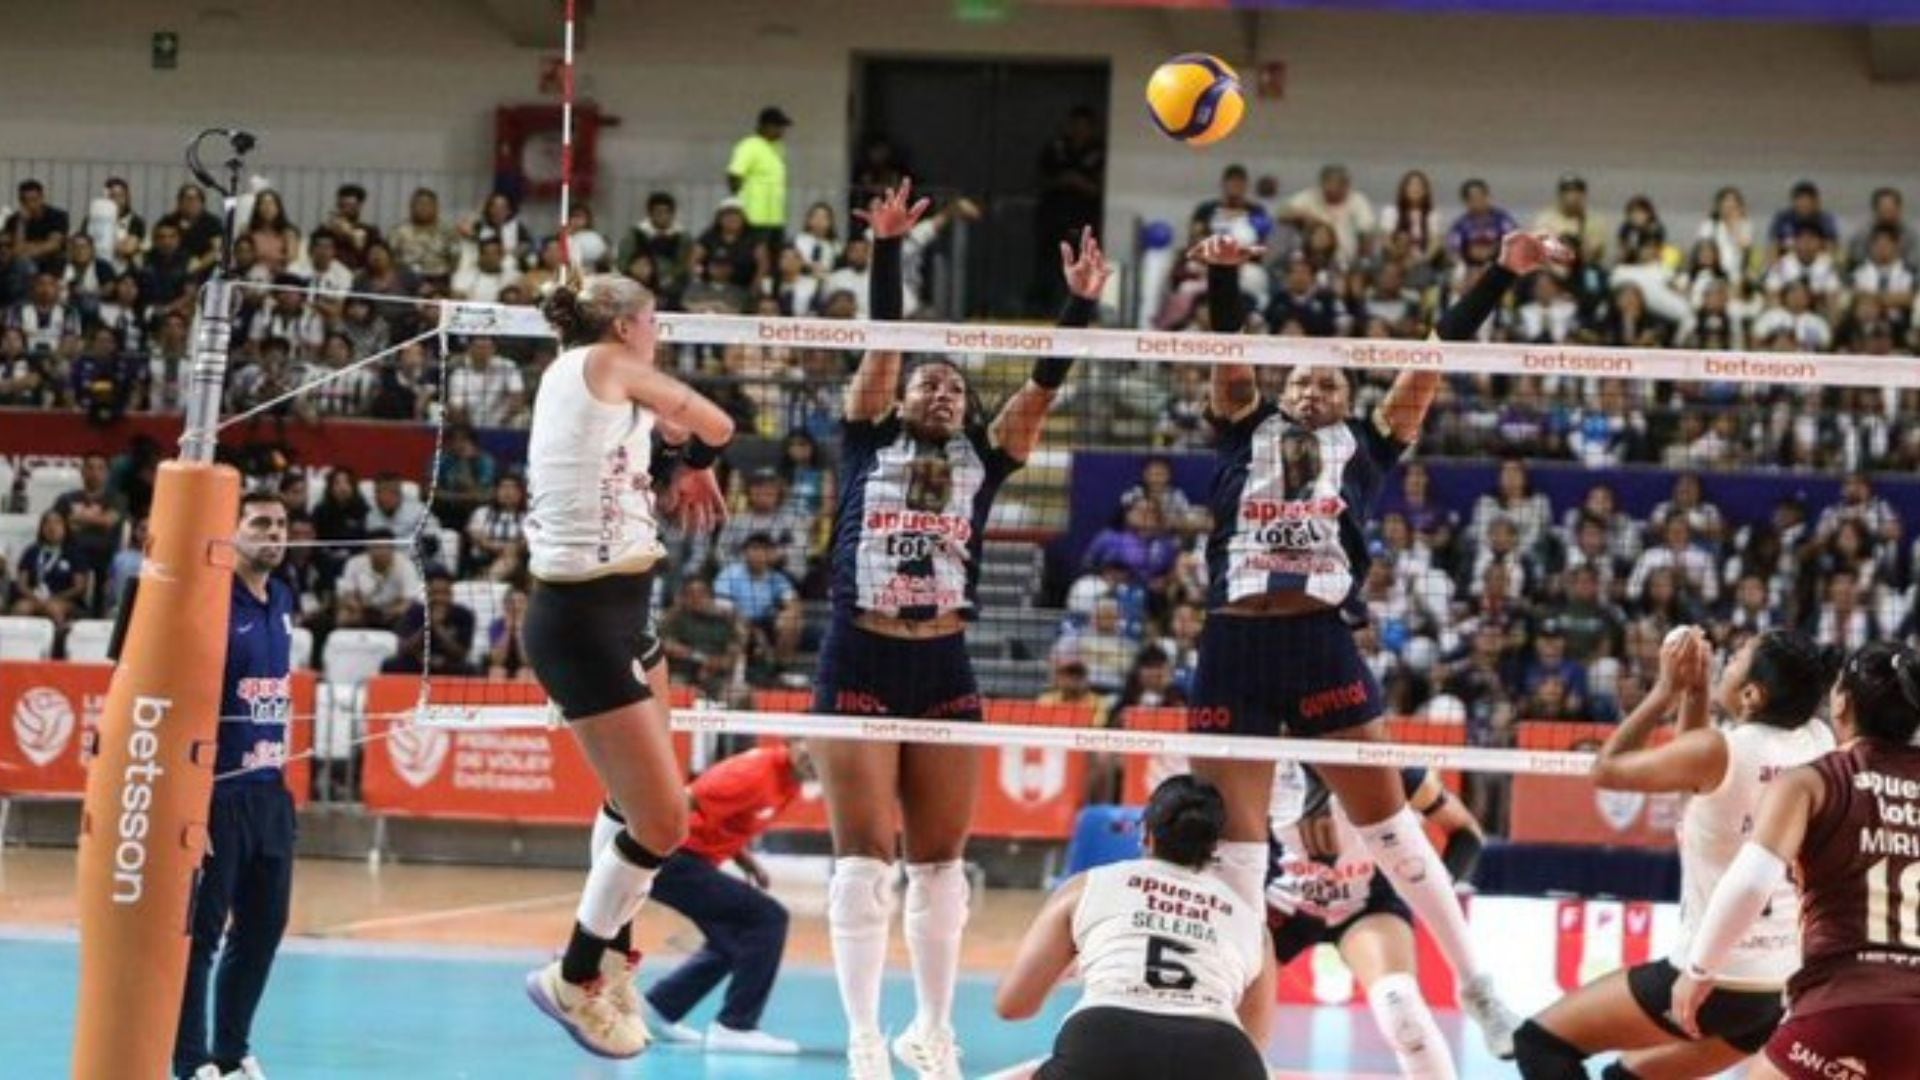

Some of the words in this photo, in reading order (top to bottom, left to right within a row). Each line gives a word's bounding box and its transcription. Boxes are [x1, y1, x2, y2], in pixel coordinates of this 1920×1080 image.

[757, 321, 867, 344] betsson
[944, 327, 1054, 351] betsson
[1135, 334, 1246, 358] betsson
[1522, 350, 1633, 373] betsson
[1704, 356, 1817, 378] betsson
[1074, 732, 1166, 749] betsson
[112, 694, 173, 905] betsson
[1127, 874, 1234, 917] apuesta
[1145, 894, 1210, 922] total
[1787, 1040, 1826, 1073] SAN
